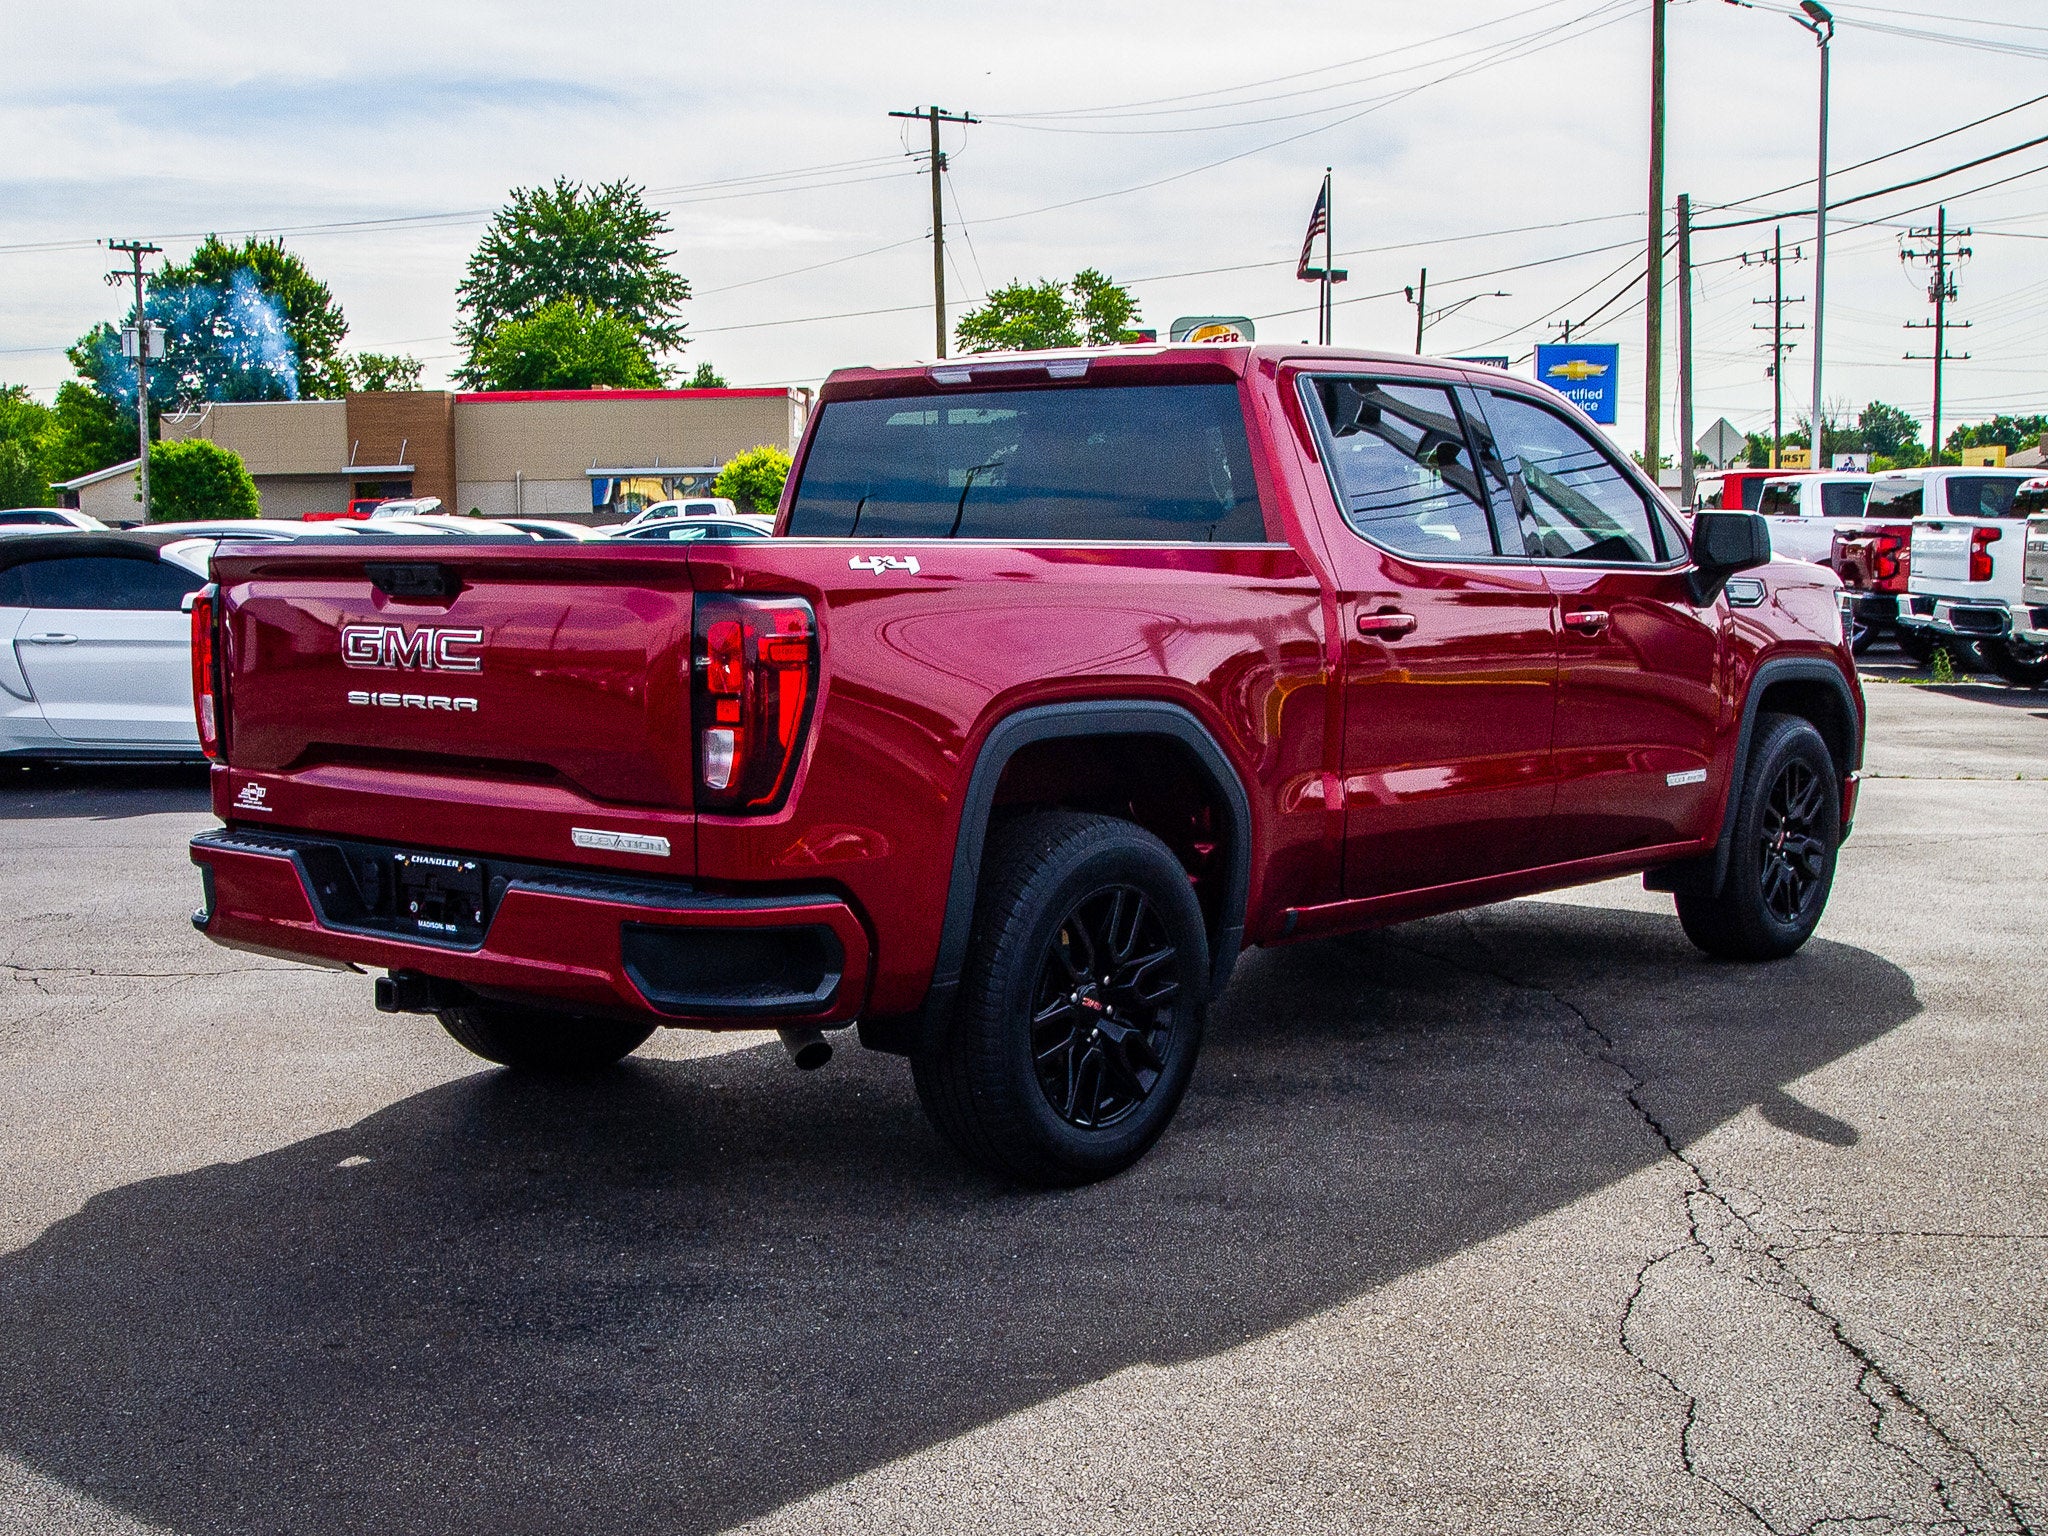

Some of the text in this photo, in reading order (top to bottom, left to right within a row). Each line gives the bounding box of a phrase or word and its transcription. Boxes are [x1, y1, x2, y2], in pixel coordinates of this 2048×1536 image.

[1557, 388, 1604, 401] ertified
[341, 625, 483, 671] GMC
[347, 690, 479, 713] SIERRA
[411, 855, 459, 867] CHANDLER
